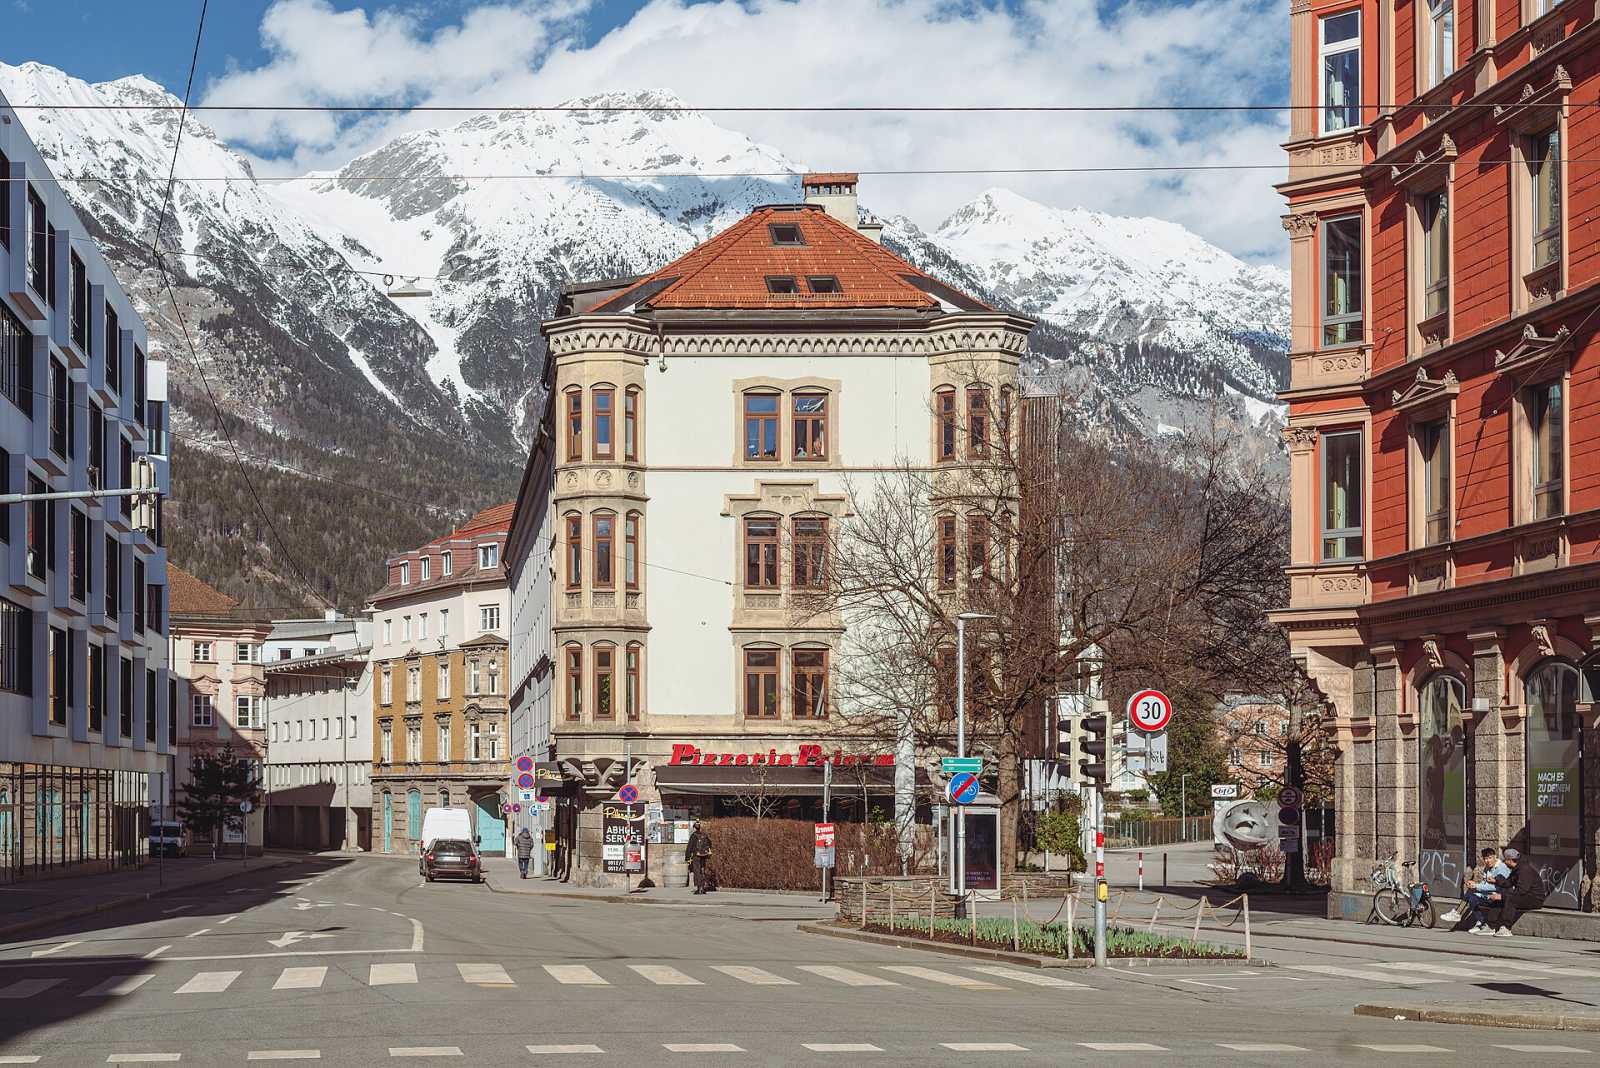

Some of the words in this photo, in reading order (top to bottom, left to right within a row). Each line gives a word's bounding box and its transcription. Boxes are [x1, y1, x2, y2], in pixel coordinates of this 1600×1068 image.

[1141, 702, 1161, 719] 30
[668, 743, 793, 766] Pizzeria
[1538, 772, 1556, 781] MACH
[1557, 772, 1565, 781] ES
[1538, 784, 1546, 793] ZU
[605, 834, 642, 843] SERVCE
